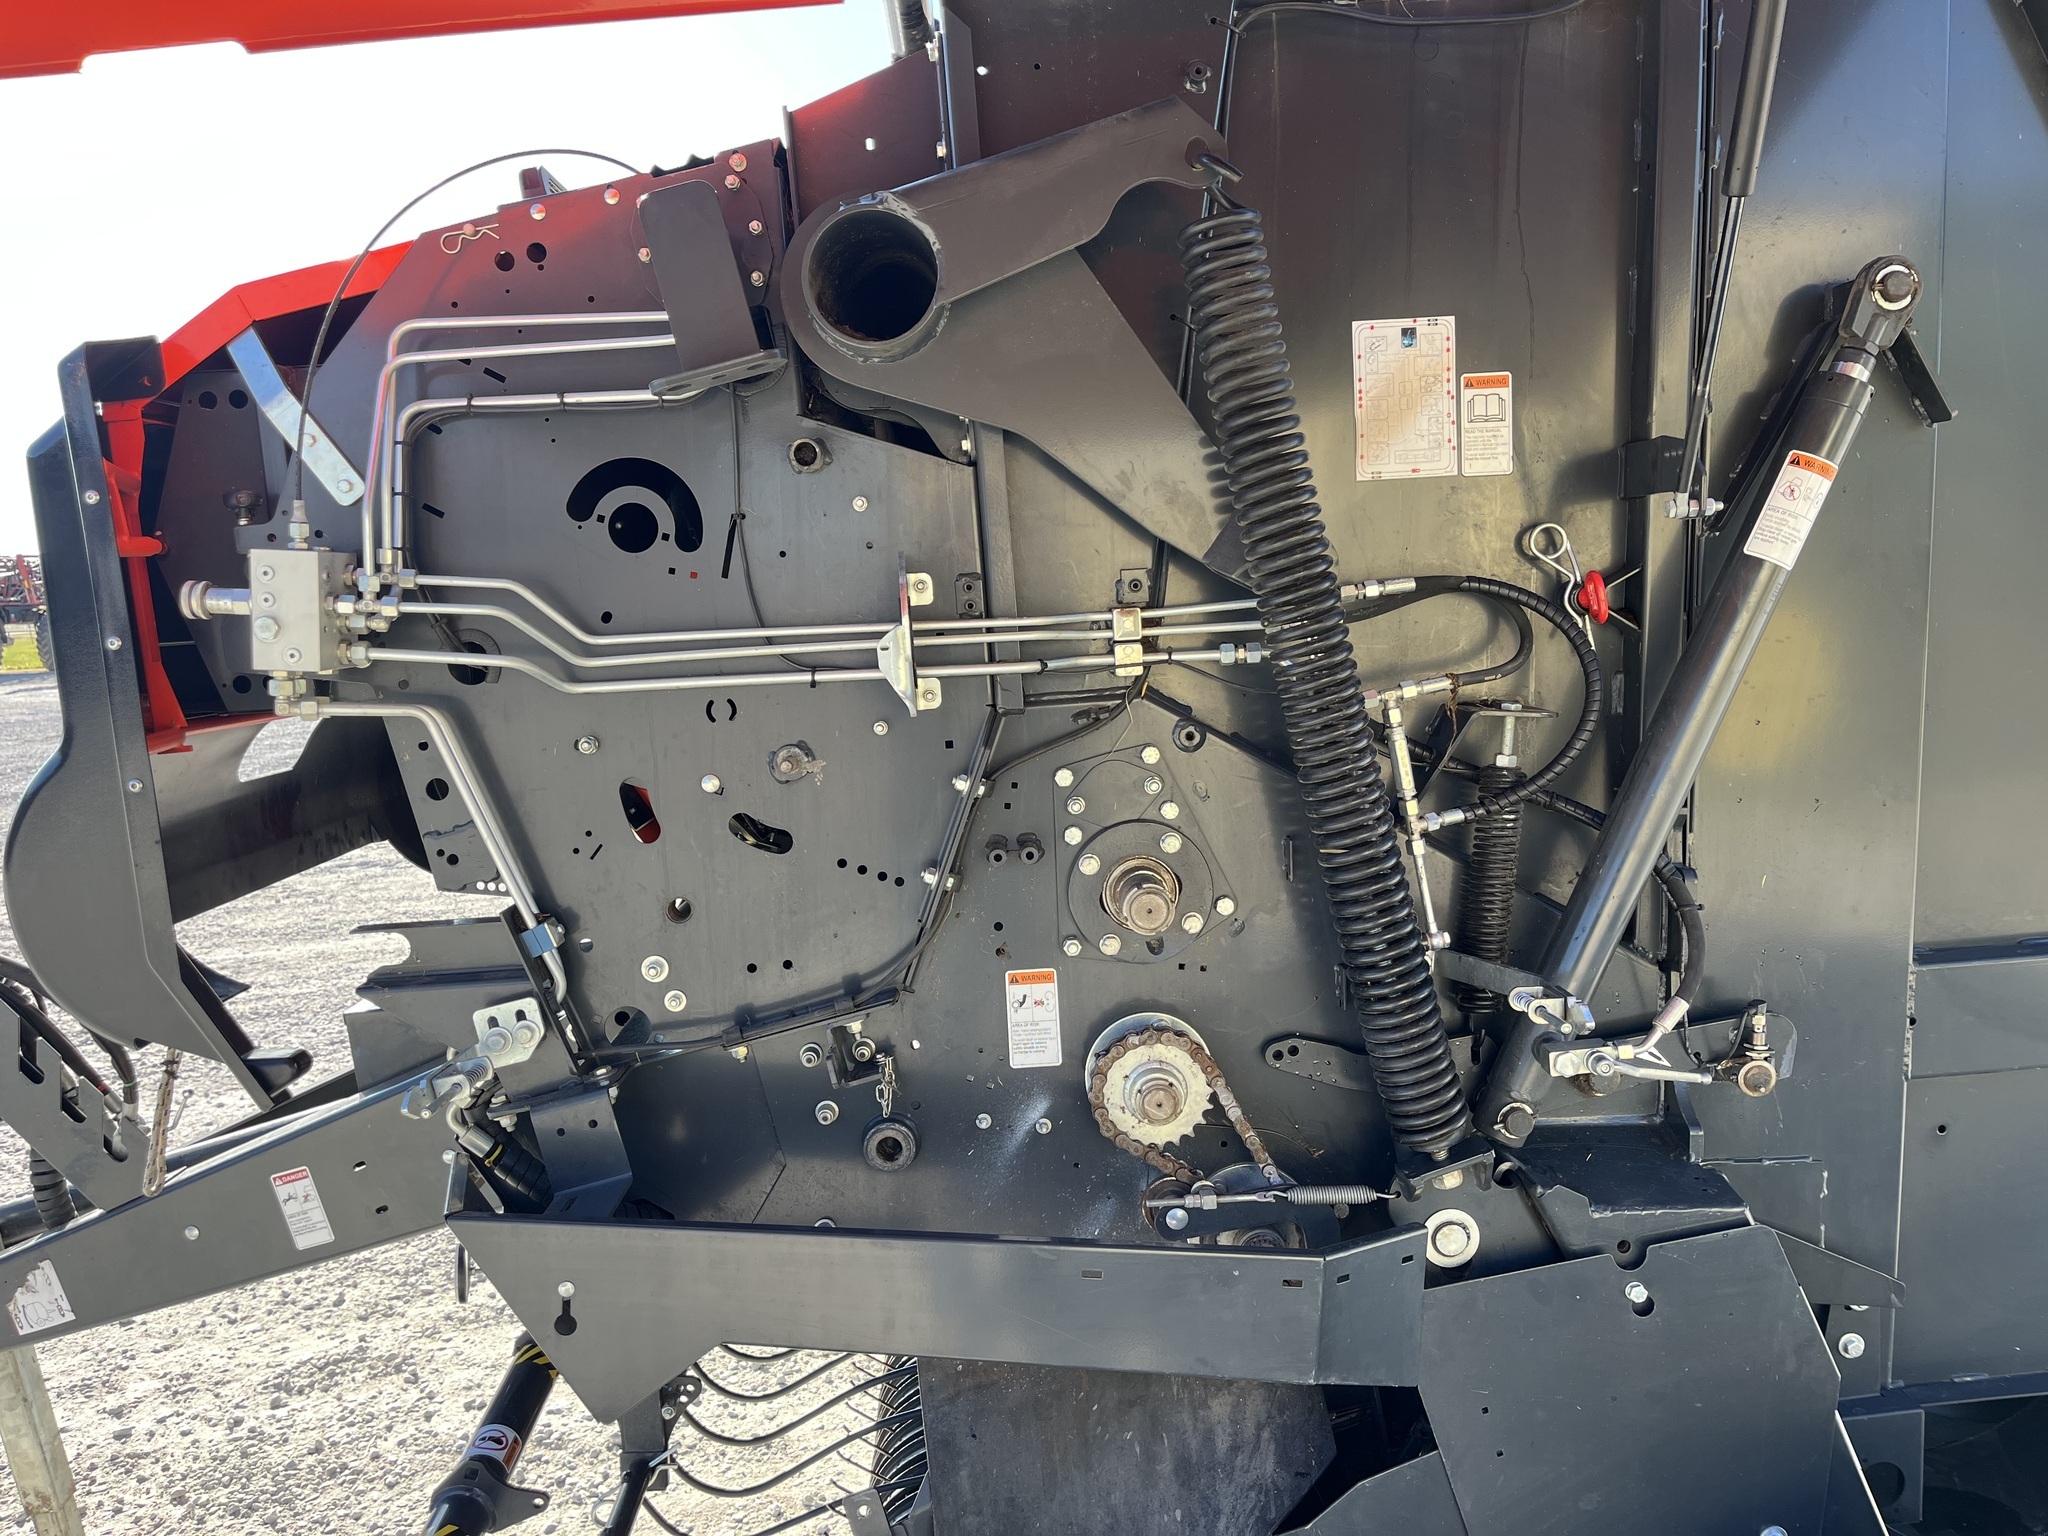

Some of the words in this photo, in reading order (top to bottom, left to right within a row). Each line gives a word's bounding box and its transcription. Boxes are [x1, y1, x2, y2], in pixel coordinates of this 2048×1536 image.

[1476, 378, 1506, 386] WARNING
[1804, 460, 1834, 477] WARNING
[282, 1170, 308, 1183] DANGER
